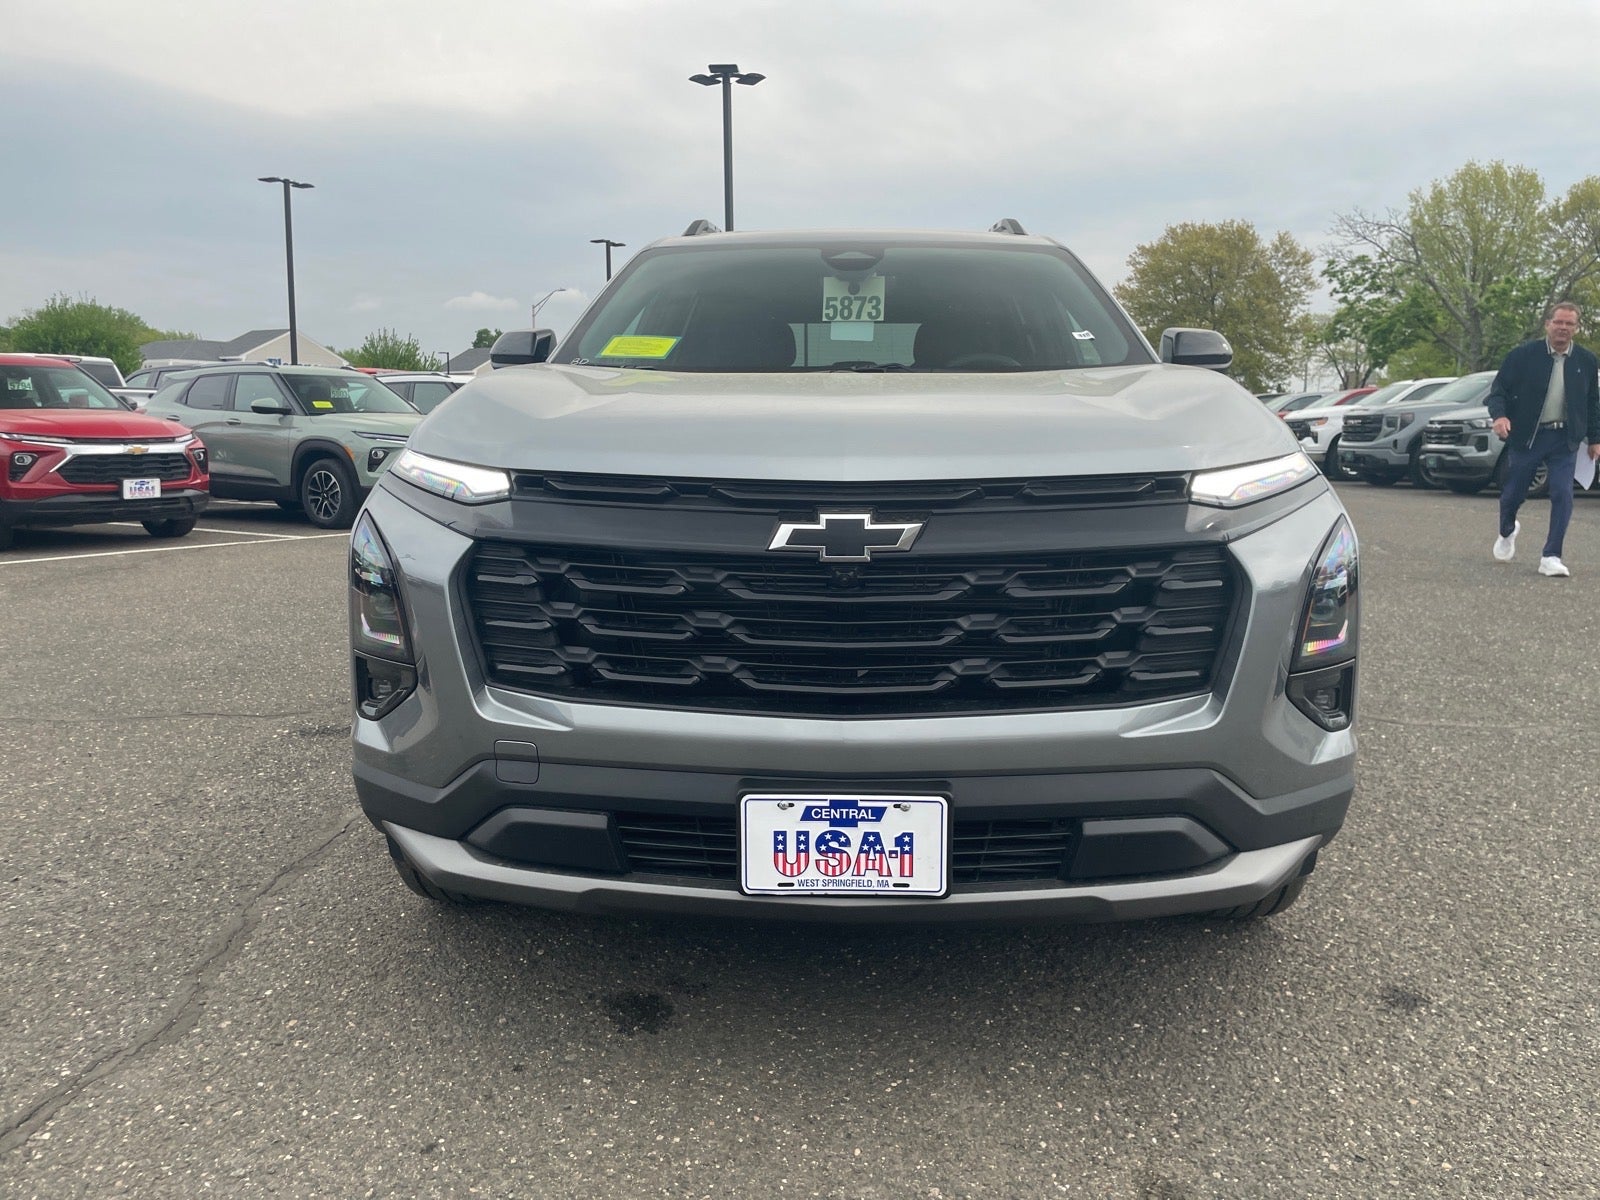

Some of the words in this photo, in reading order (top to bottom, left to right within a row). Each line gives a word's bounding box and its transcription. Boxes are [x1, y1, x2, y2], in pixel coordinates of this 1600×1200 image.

[824, 296, 881, 320] 5873
[811, 808, 877, 820] CENTRAL
[797, 879, 821, 888] WEST
[822, 879, 875, 889] SPRINGFIELD,
[876, 879, 890, 888] MA
